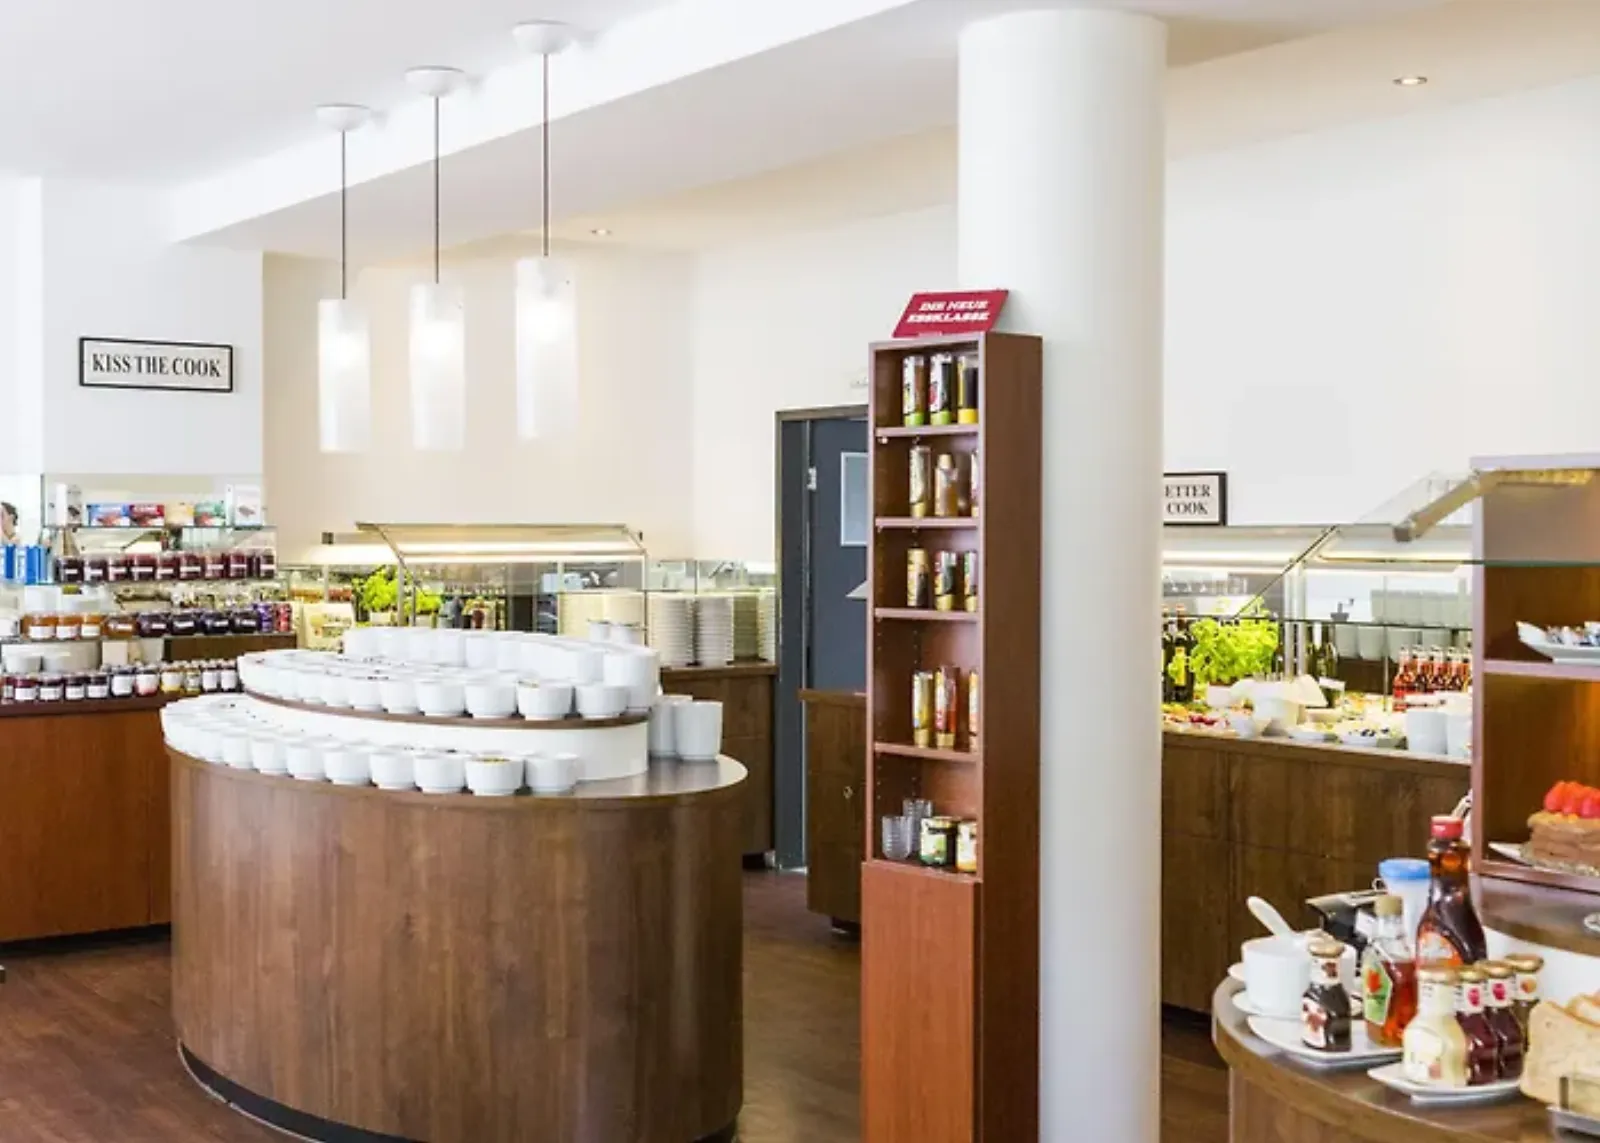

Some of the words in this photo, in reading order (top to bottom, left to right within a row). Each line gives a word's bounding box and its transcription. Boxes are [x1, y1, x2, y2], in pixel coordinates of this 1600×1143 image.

[92, 353, 132, 373] KISS
[134, 356, 169, 375] THE
[172, 357, 221, 378] COOK
[1166, 501, 1208, 515] COOK
